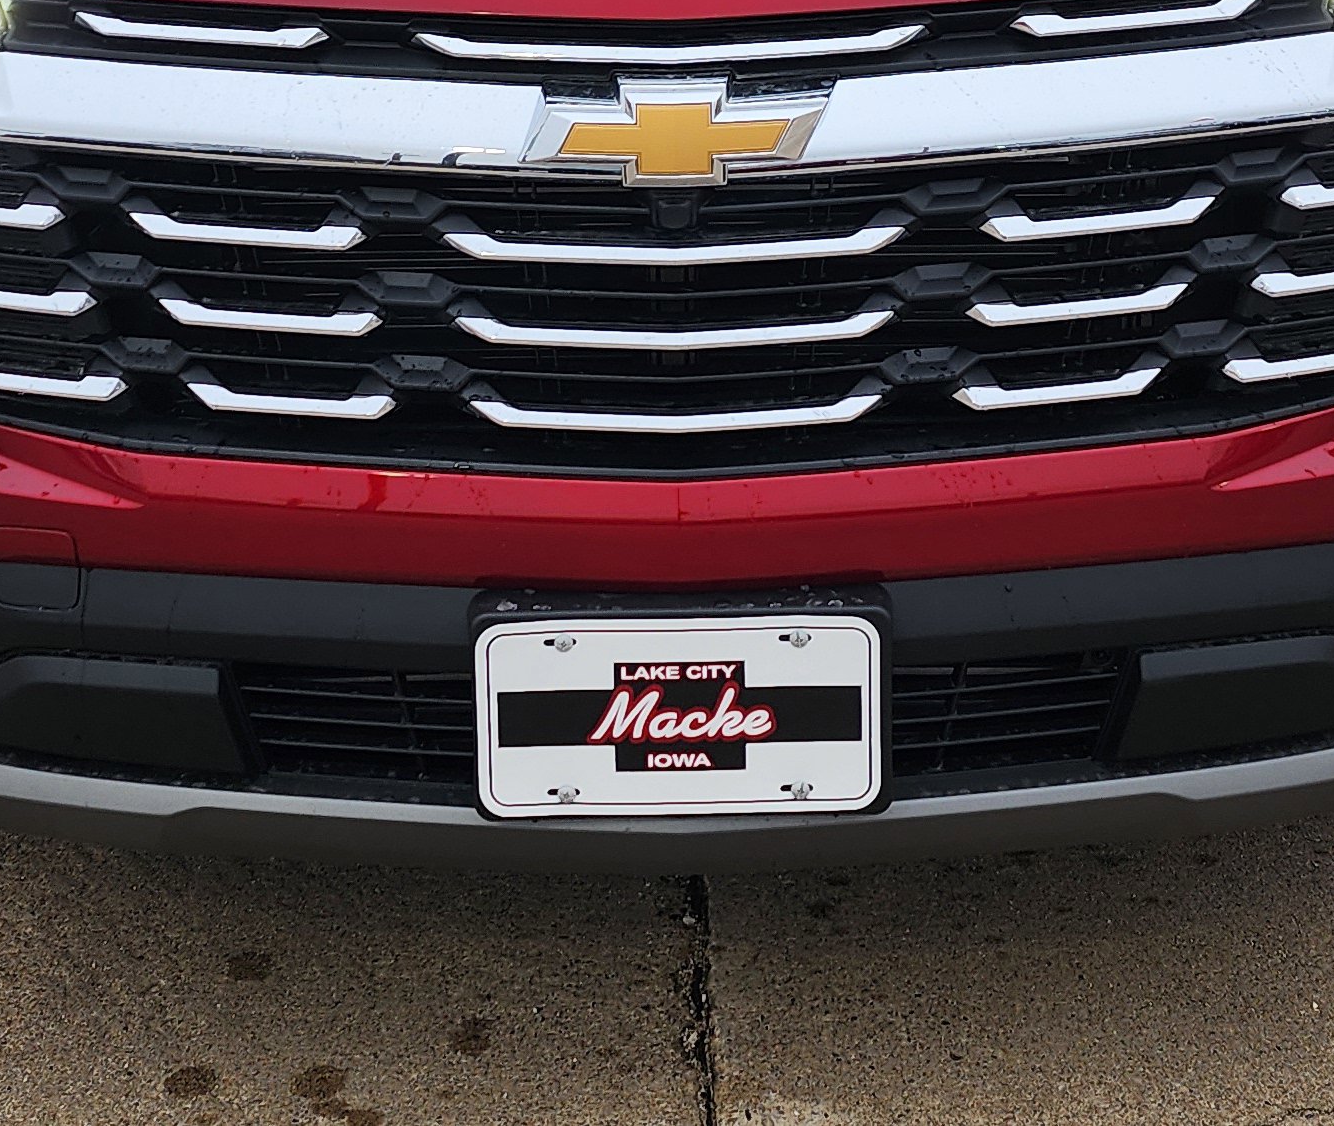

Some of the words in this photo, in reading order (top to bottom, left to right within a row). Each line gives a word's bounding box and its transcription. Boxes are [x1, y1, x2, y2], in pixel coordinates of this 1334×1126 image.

[619, 664, 681, 681] LAKE
[685, 663, 738, 680] CITY
[588, 684, 774, 742] Macke
[647, 752, 712, 770] IOWA
